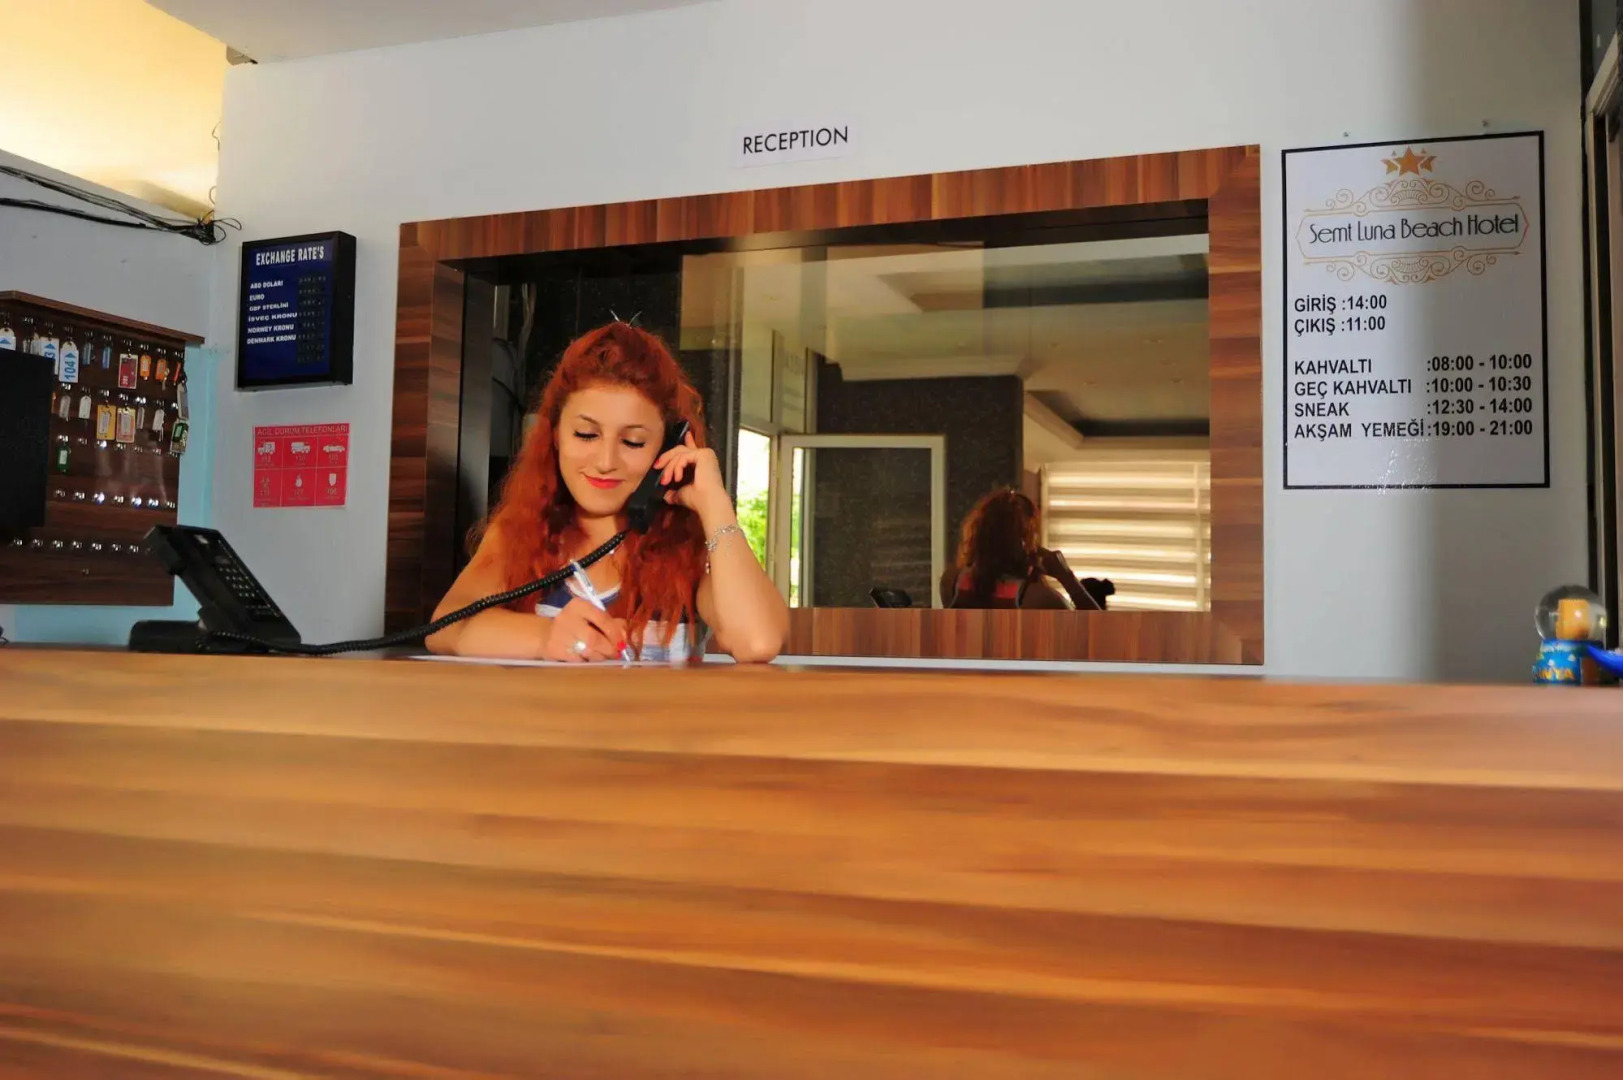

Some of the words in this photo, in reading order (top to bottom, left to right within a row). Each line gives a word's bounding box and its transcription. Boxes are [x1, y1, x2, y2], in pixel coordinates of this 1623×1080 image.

[743, 125, 848, 155] RECEPTION
[1309, 222, 1353, 244] Semt
[1357, 220, 1396, 241] Luna
[1400, 217, 1463, 239] Beach
[1467, 213, 1519, 236] Hotel
[255, 249, 296, 266] EXCHANGE
[297, 246, 325, 262] RATE'S
[1294, 294, 1337, 315] GİRİŞ
[271, 312, 298, 320] KRONU
[273, 324, 295, 332] KRONU
[276, 334, 297, 342] KRONU
[1294, 318, 1336, 338] ÇIKIŞ
[64, 360, 77, 379] 104
[1294, 358, 1373, 375] KAHVALTI
[1489, 353, 1533, 369] 10:00
[1294, 381, 1328, 400] GEÇ
[1333, 378, 1412, 396] KAHVALTI
[1488, 375, 1532, 392] 10:30
[1294, 402, 1350, 417] SNEAK
[1489, 397, 1533, 414] 14:00
[1294, 423, 1352, 442] AKŞAM
[1489, 419, 1533, 436] 21:00
